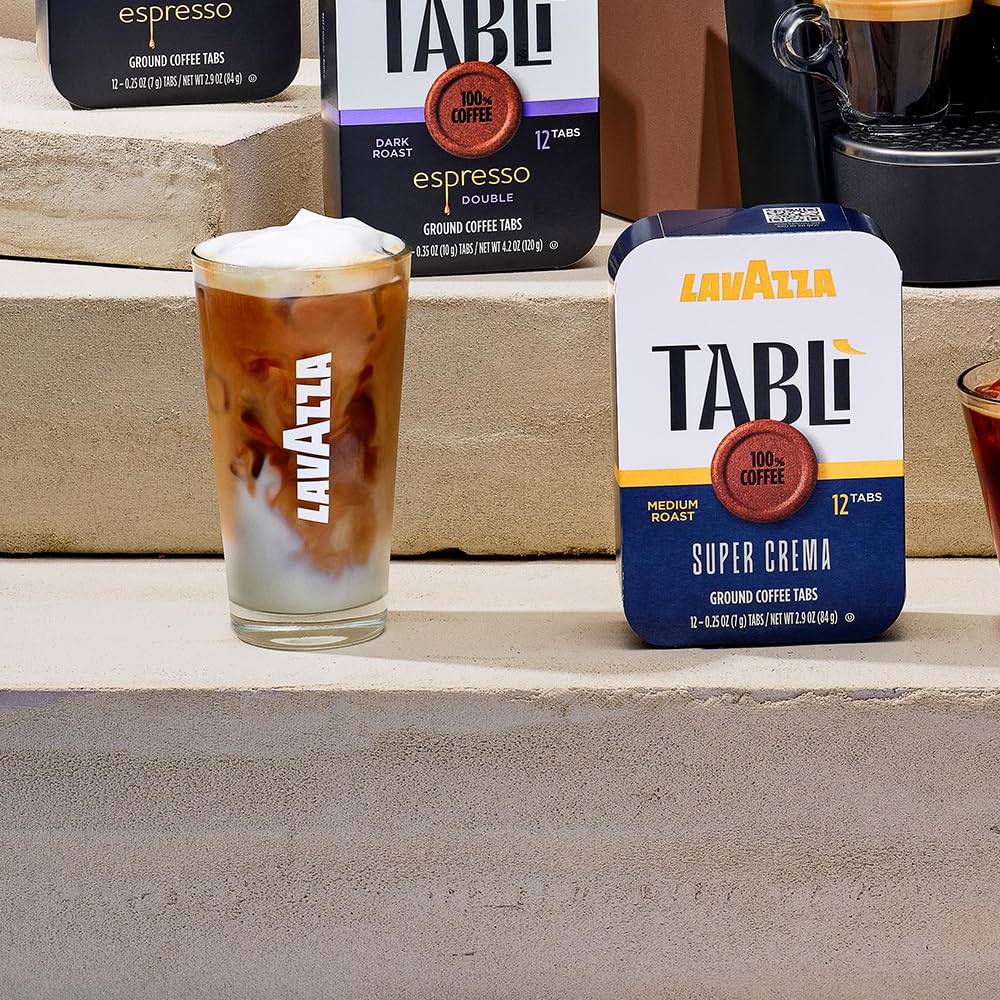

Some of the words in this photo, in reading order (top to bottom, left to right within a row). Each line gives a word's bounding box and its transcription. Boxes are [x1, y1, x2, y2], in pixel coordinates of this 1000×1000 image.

[119, 2, 232, 41] espresso
[129, 55, 167, 68] GROUND
[170, 54, 200, 66] COFFEE
[203, 52, 225, 64] TABS
[163, 76, 177, 87] TABS
[183, 75, 193, 86] NET
[195, 74, 205, 85] WT
[460, 90, 493, 106] 100%
[451, 106, 493, 124] COFFEE
[376, 137, 409, 148] DARK
[535, 130, 550, 150] 12
[551, 128, 581, 138] TABS
[373, 148, 413, 159] ROAST
[413, 166, 531, 207] espresso
[462, 193, 514, 205] DOUBLE
[423, 221, 463, 236] GROUND
[465, 219, 498, 234] COFFEE
[500, 217, 523, 231] TABS
[459, 242, 474, 255] TABS
[479, 241, 491, 254] NET
[491, 241, 501, 253] WT
[679, 259, 837, 302] LAVAZZA
[282, 352, 333, 524] LAVAZZA
[750, 451, 785, 468] 100%
[740, 468, 785, 486] COFFEE
[647, 499, 699, 511] MEDIUM
[832, 493, 849, 516] 12
[850, 492, 883, 503] TABS
[651, 511, 695, 522] ROAST
[692, 541, 754, 576] SUPER
[765, 538, 831, 573] CREMA
[710, 591, 753, 605] GROUND
[755, 589, 791, 603] COFFEE
[793, 587, 818, 601] TABS
[748, 613, 764, 626] TABS
[770, 612, 783, 626] NET
[783, 612, 795, 625] WT
